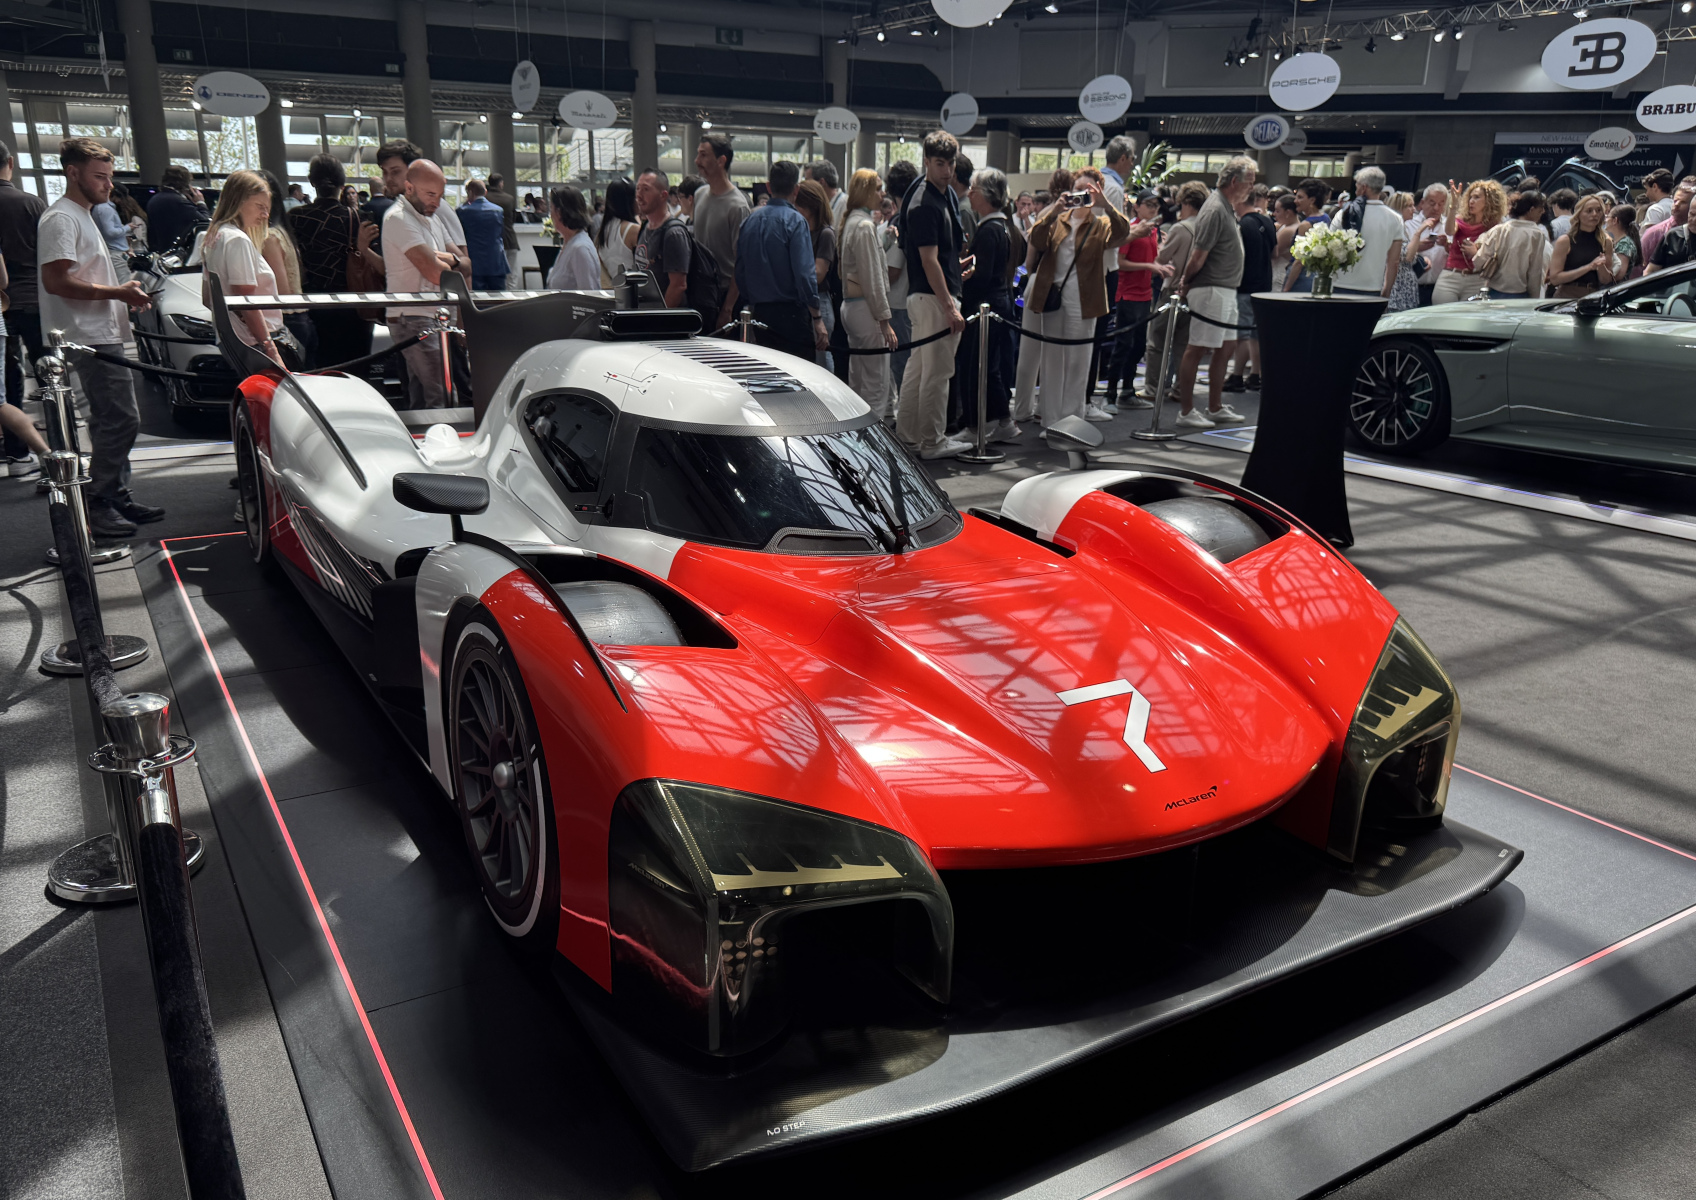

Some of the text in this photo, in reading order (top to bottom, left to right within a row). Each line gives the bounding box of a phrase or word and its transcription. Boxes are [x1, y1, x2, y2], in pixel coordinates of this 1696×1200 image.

[1272, 75, 1336, 88] PORSCHE
[216, 91, 266, 99] DENZA
[817, 120, 858, 131] ZEEKR
[1253, 121, 1280, 142] DELAGE
[1589, 139, 1619, 149] Emotion
[1055, 678, 1168, 773] 7
[1164, 788, 1217, 811] McLaren
[627, 862, 666, 889] McLaren
[766, 1120, 806, 1136] NO STEP
